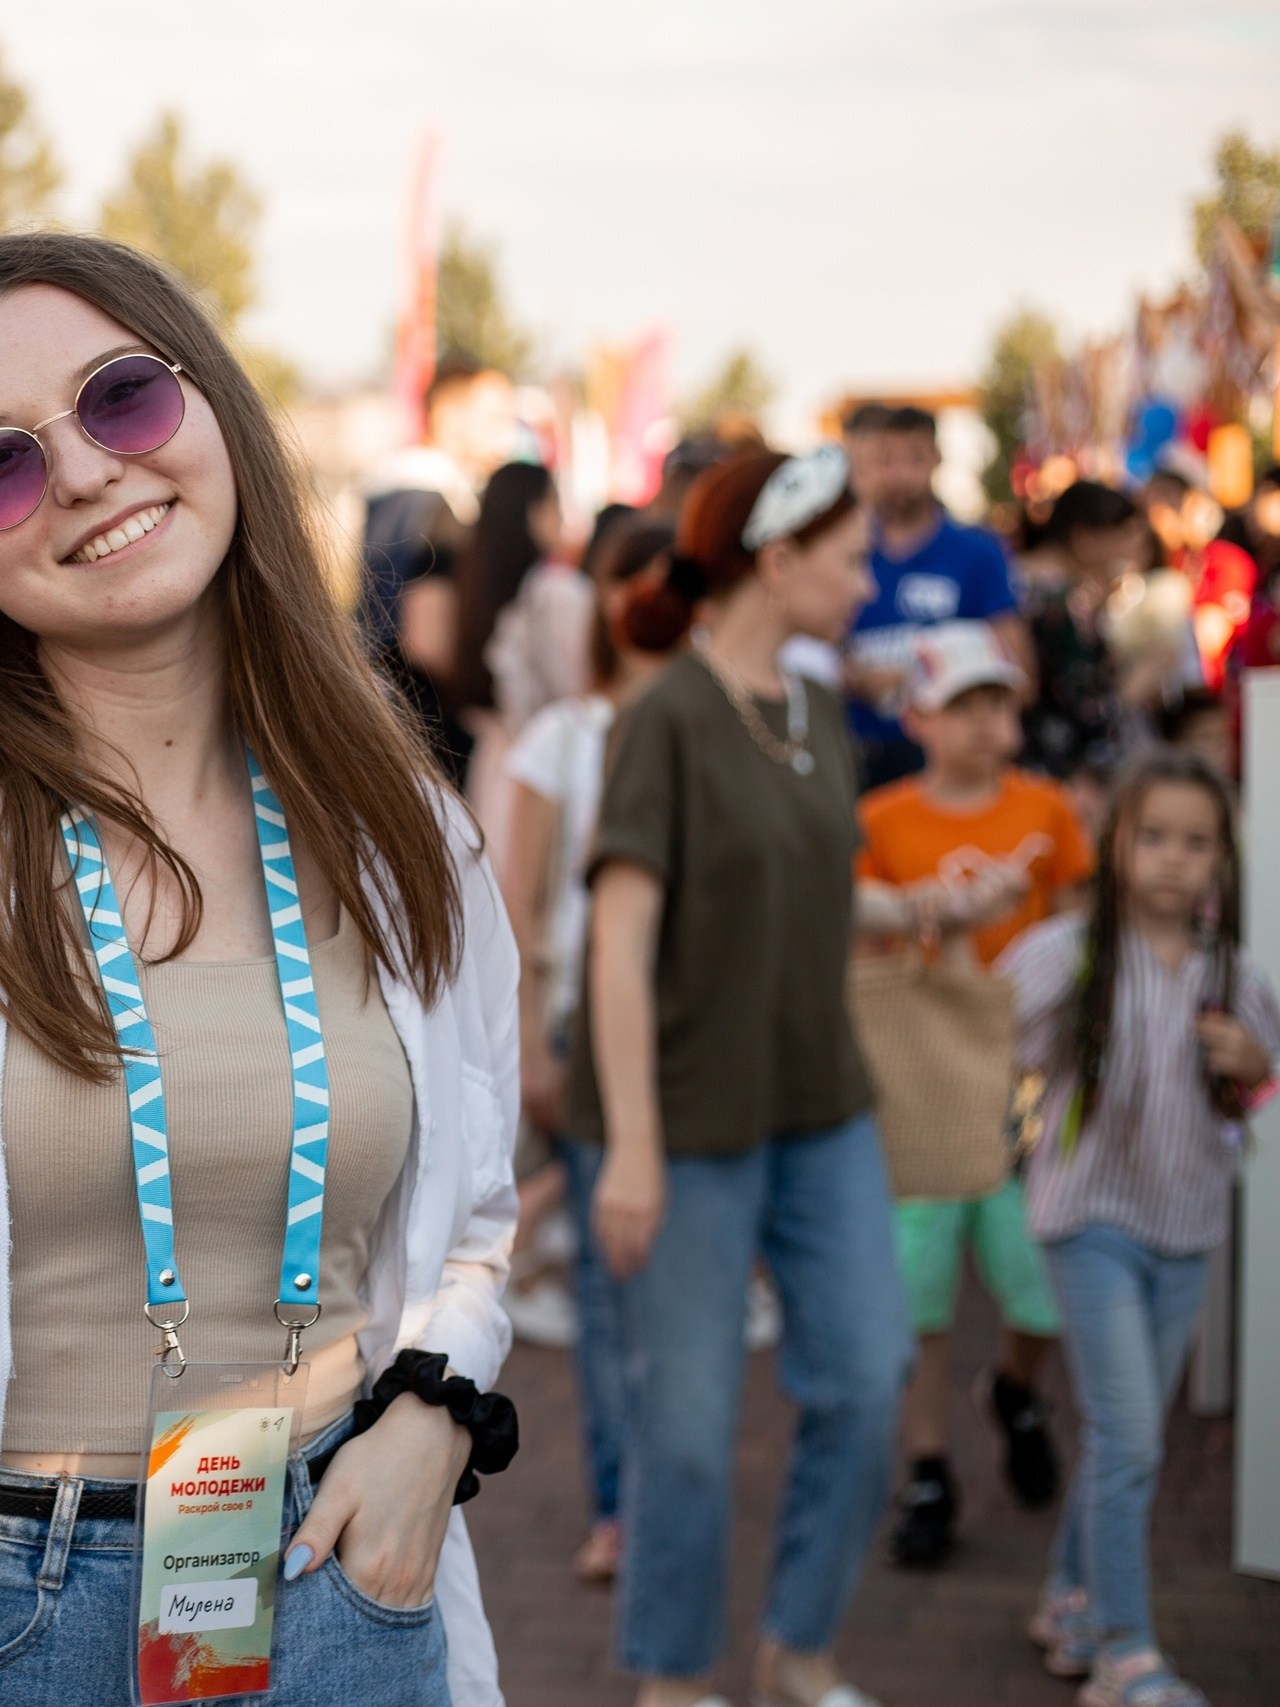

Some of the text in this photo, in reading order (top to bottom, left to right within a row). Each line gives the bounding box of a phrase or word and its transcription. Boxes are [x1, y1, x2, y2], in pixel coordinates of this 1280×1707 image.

[197, 1456, 241, 1474] ДЕНЬ
[171, 1477, 266, 1496] МОЛОДЕЖИ
[178, 1502, 219, 1515] Раскрой
[245, 1500, 253, 1510] Я
[163, 1551, 260, 1573] Организатор
[168, 1594, 235, 1622] Милена
